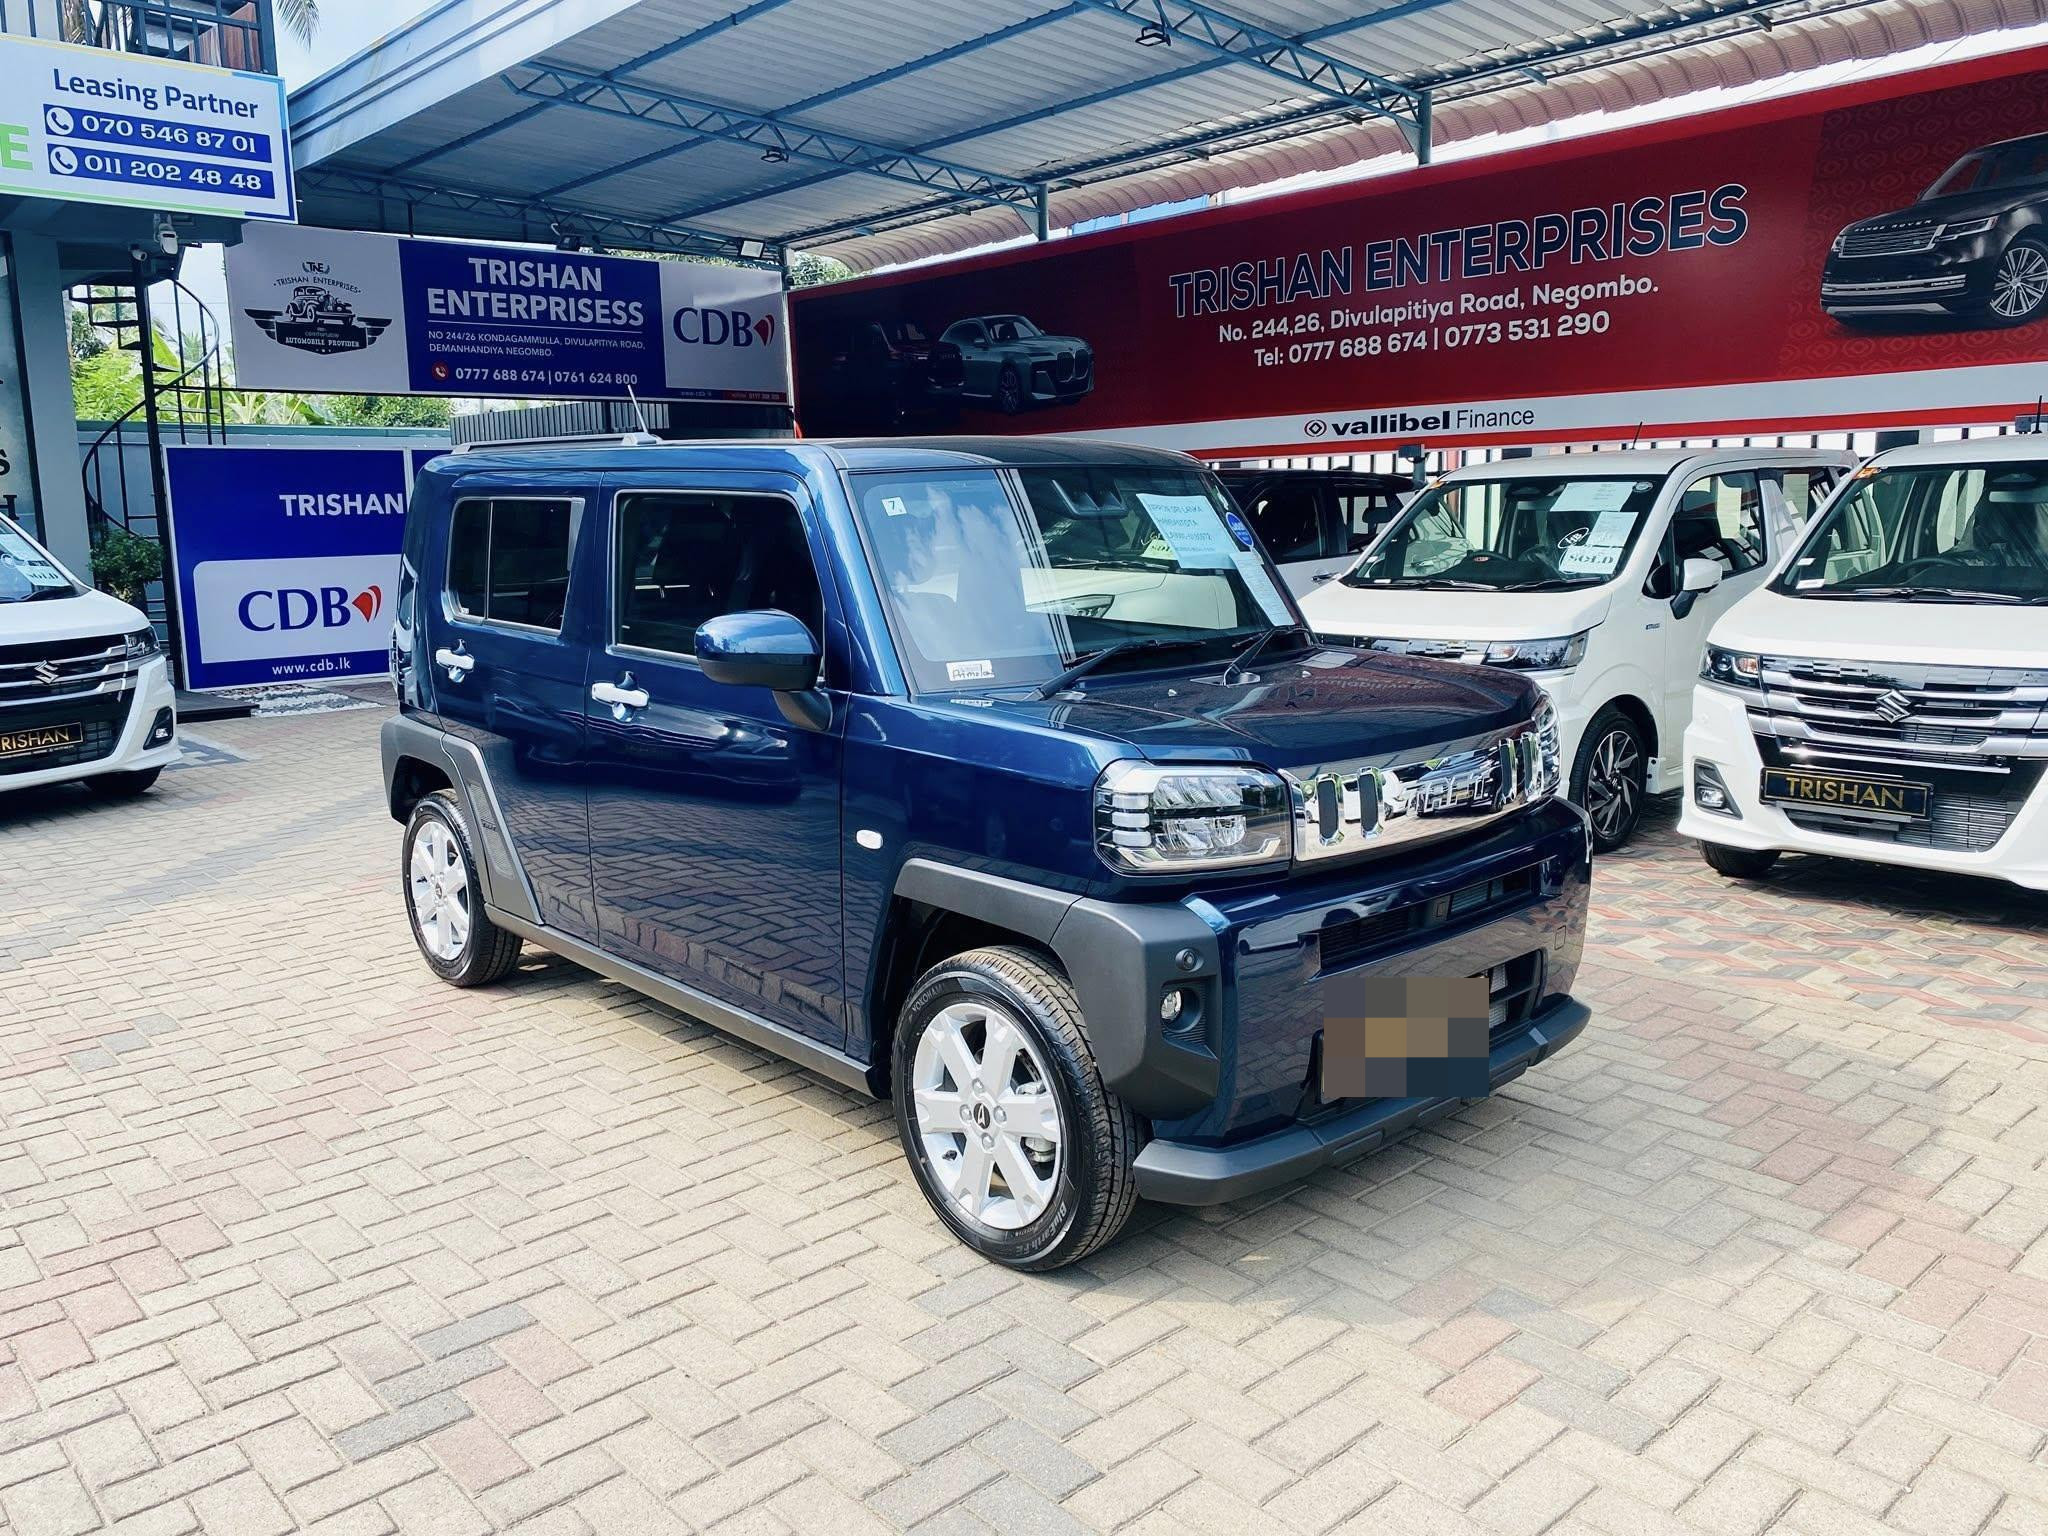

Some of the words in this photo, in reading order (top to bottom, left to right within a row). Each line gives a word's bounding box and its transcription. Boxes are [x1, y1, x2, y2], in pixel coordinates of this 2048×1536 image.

[54, 68, 158, 110] Leasing
[165, 86, 258, 118] Partner
[82, 116, 133, 137] 070
[140, 124, 189, 145] 546
[196, 132, 225, 150] 87
[232, 136, 256, 153] 01
[84, 155, 122, 175] 011
[130, 161, 181, 182] 202
[189, 168, 222, 186] 48
[230, 173, 262, 190] 48
[1168, 246, 1352, 318] TRISHAN
[1366, 183, 1749, 292] ENTERPRISES
[276, 276, 309, 286] TRISHAN
[313, 276, 358, 293] ENTERPRISES
[468, 257, 602, 292] TRISHAN
[427, 288, 644, 327] ENTERPRISESS
[1219, 324, 1248, 343] No.
[1252, 313, 1325, 339] 244,26,
[1330, 299, 1453, 330] Divulapitiya
[1460, 288, 1525, 315] Road,
[1532, 274, 1659, 310] Negombo.
[285, 337, 326, 346] AUTOMOBILE
[428, 331, 443, 340] NO
[446, 332, 476, 341] 244/26
[564, 337, 618, 349] DIVULAPITIYA
[672, 306, 753, 347] CDB
[1254, 347, 1284, 367] Tel:
[1288, 341, 1335, 364] 0777
[1340, 335, 1382, 358] 688
[1387, 331, 1428, 353] 674
[1445, 322, 1502, 348] 0773
[1508, 318, 1551, 341] 531
[1557, 311, 1610, 336] 290
[429, 343, 504, 356] DEMANHANDIYA
[455, 368, 489, 381] 0777
[493, 369, 518, 381] 688
[521, 370, 545, 382] 674
[554, 371, 585, 384] 0761
[589, 372, 612, 384] 624
[615, 373, 638, 385] 800
[1331, 410, 1450, 436] vallibel
[1456, 409, 1535, 430] Finance
[279, 493, 404, 517] TRISHAN
[238, 586, 351, 632] CDB
[272, 657, 351, 676] www.cdb.lk
[0, 728, 70, 751] RISHAN
[1786, 777, 1904, 809] TRISHAN
